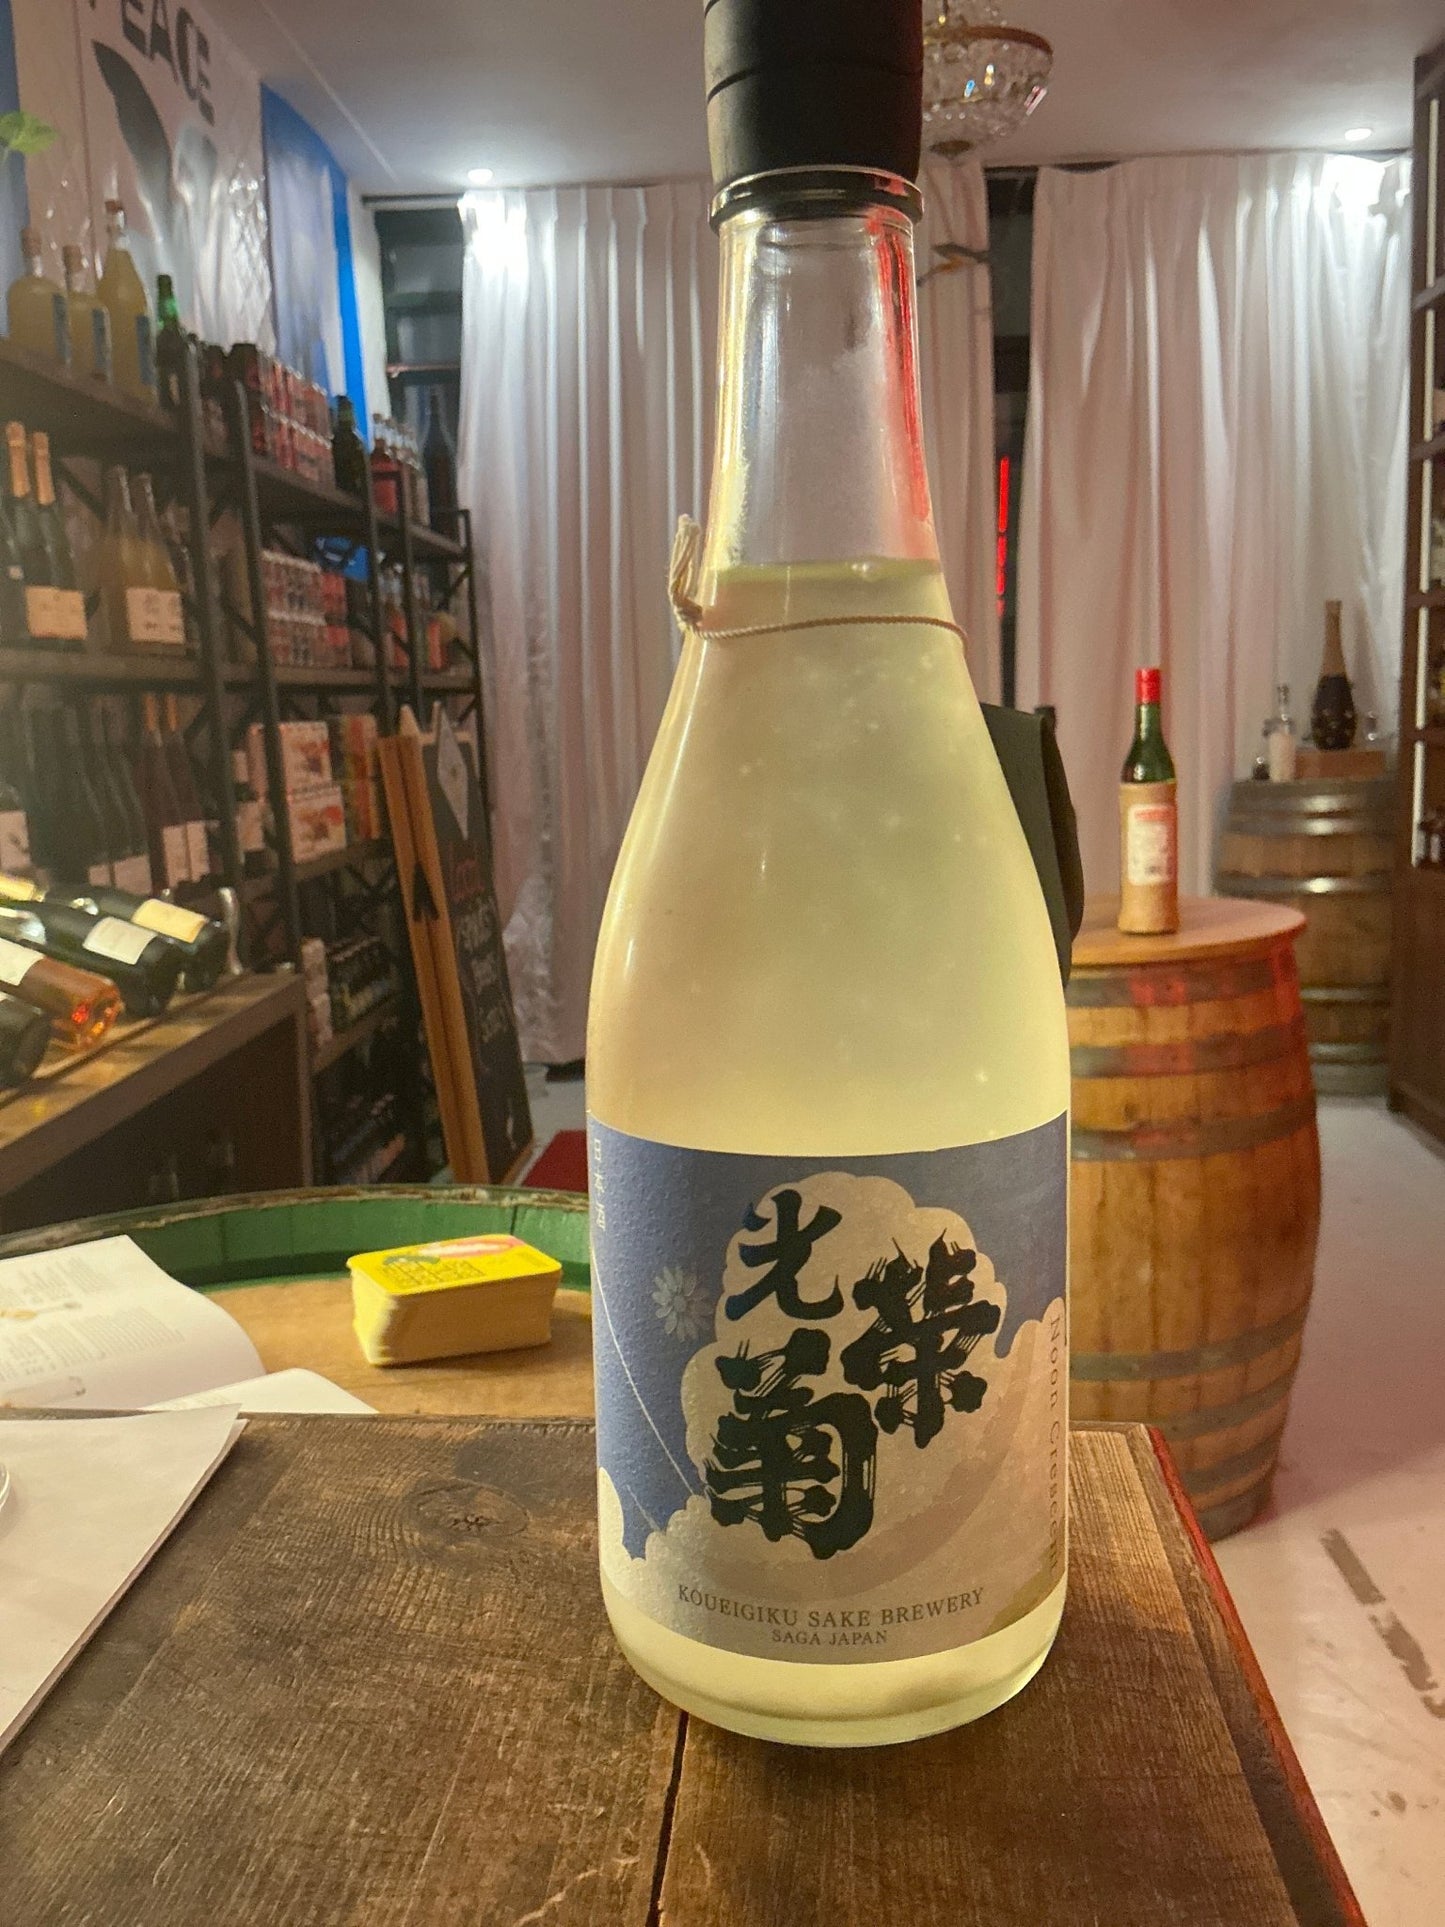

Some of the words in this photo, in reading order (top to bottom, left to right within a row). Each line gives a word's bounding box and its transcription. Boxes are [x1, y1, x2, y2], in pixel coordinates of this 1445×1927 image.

[89, 0, 215, 127] EACE
[1049, 1314, 1061, 1409] Noon
[1049, 1420, 1061, 1570] Crescent
[678, 1584, 799, 1627] KOUEIGIKU
[807, 1610, 871, 1628] SAKE
[881, 1586, 985, 1626] BREWERY
[771, 1628, 821, 1645] SAGA
[828, 1629, 888, 1646] JAPAN
